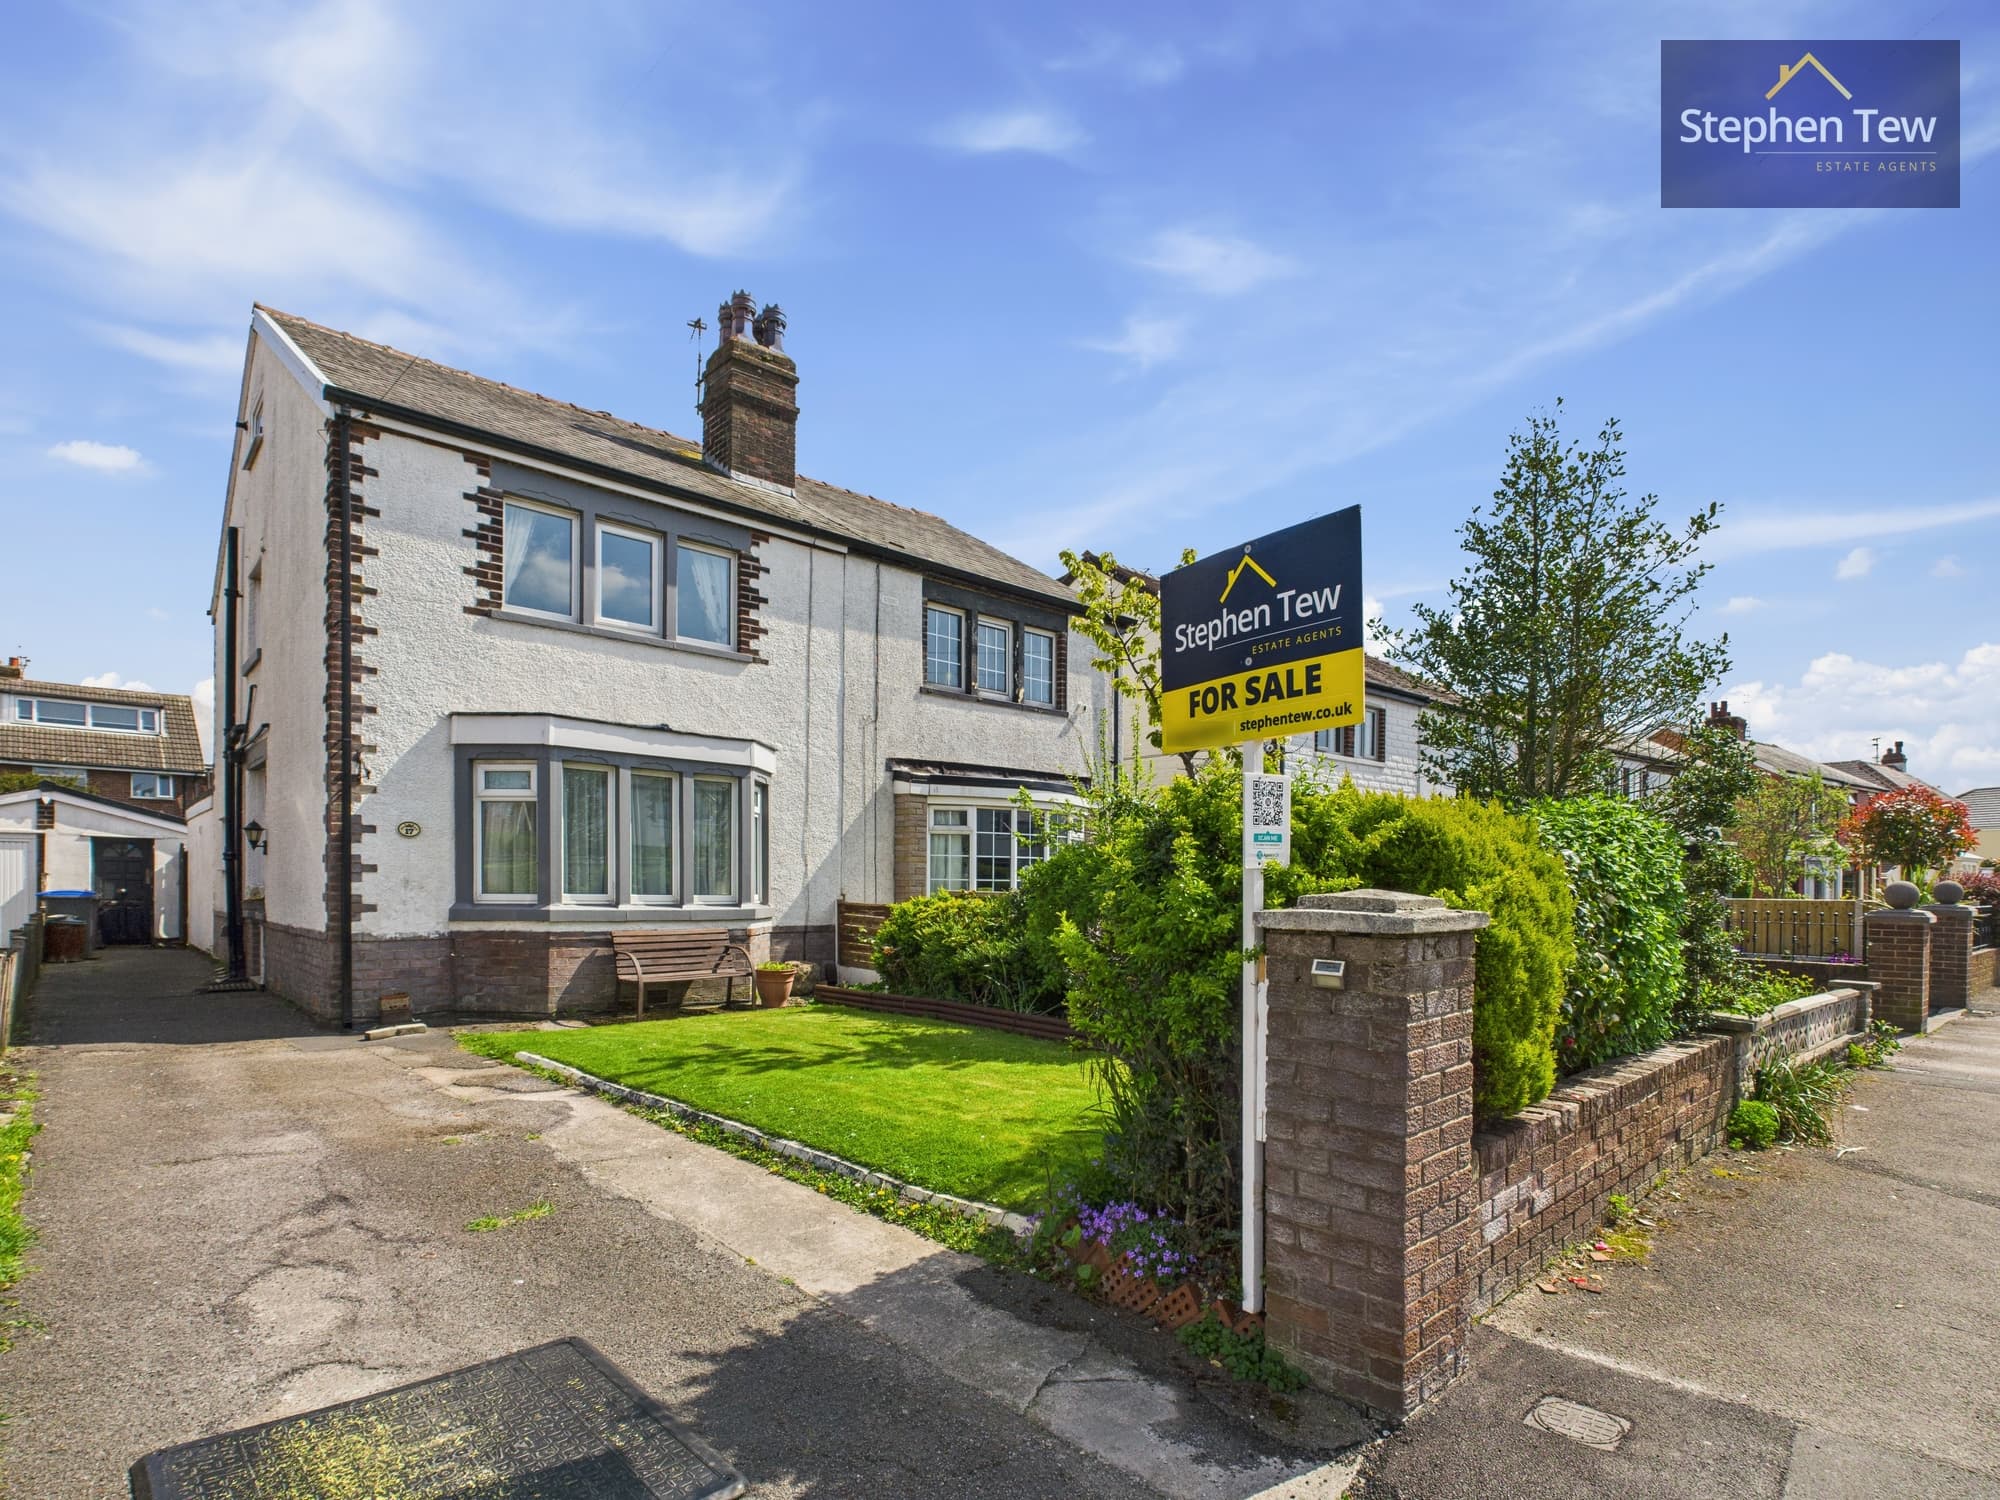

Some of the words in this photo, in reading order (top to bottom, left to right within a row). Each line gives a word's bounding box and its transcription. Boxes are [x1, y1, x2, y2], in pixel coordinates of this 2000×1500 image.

[1175, 604, 1271, 652] Stephen
[1277, 584, 1342, 622] Tew
[1252, 637, 1291, 655] ESTATE
[1296, 625, 1342, 645] AGENTS
[1189, 682, 1238, 718] FOR
[1245, 663, 1322, 706] SALE
[1241, 702, 1352, 732] stephentew.co.uk
